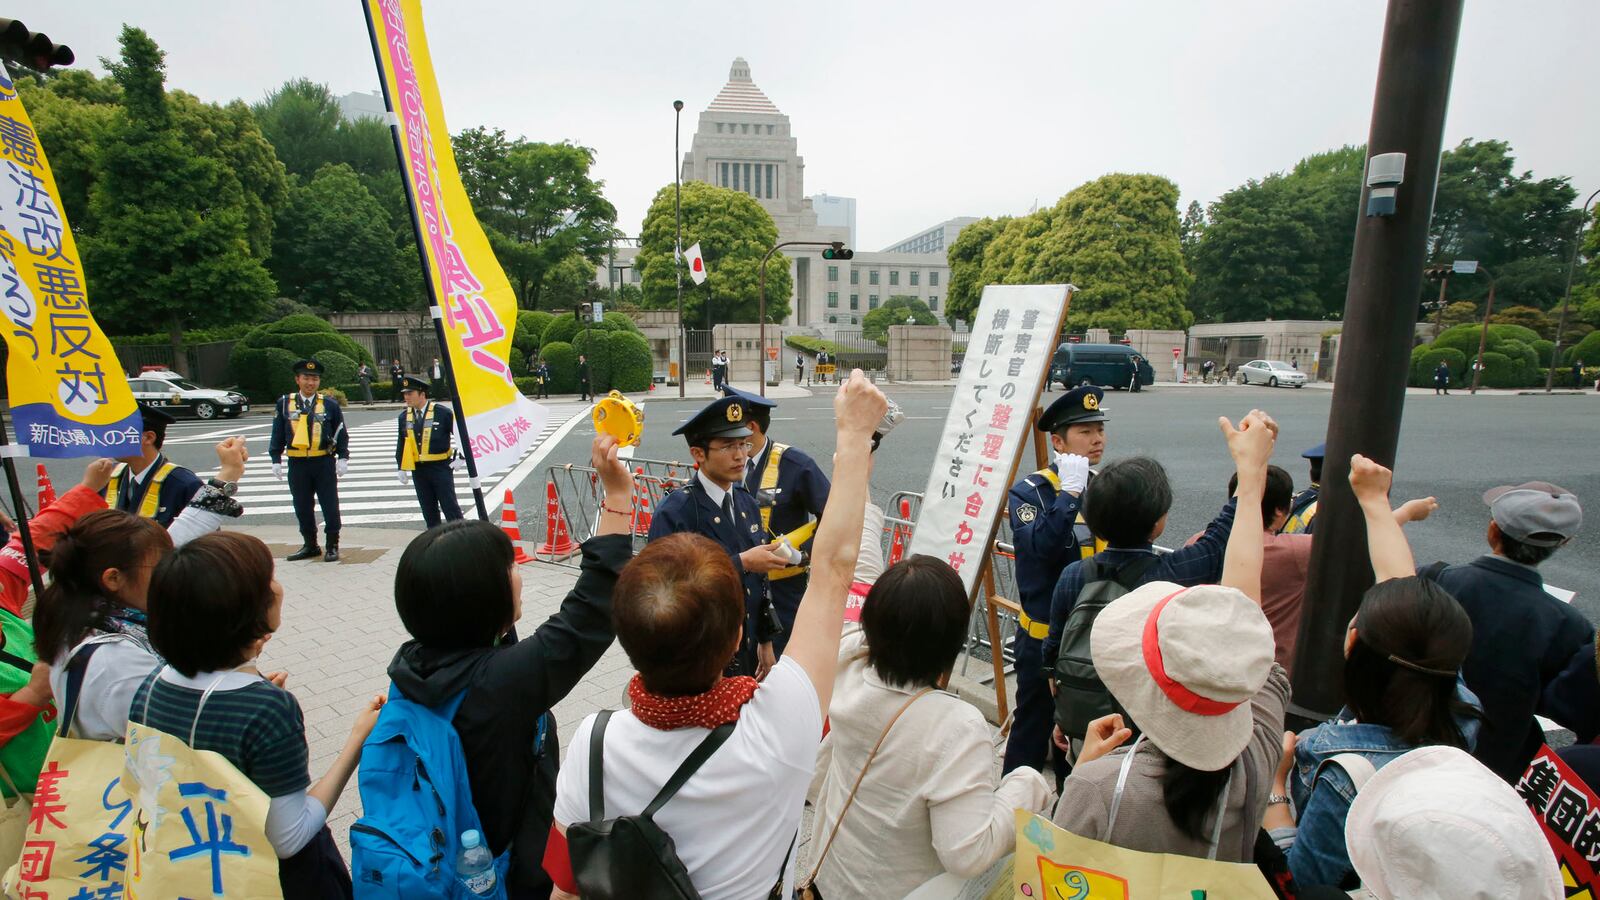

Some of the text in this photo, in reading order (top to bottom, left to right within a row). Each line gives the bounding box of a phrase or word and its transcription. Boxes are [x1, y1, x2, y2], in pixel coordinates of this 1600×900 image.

[0, 113, 110, 406] 憲法改悪反対
[29, 422, 140, 448] 新日本婦人の会
[941, 308, 1011, 500] 横断してください
[947, 308, 1041, 578] 警察官の整理に合わせ
